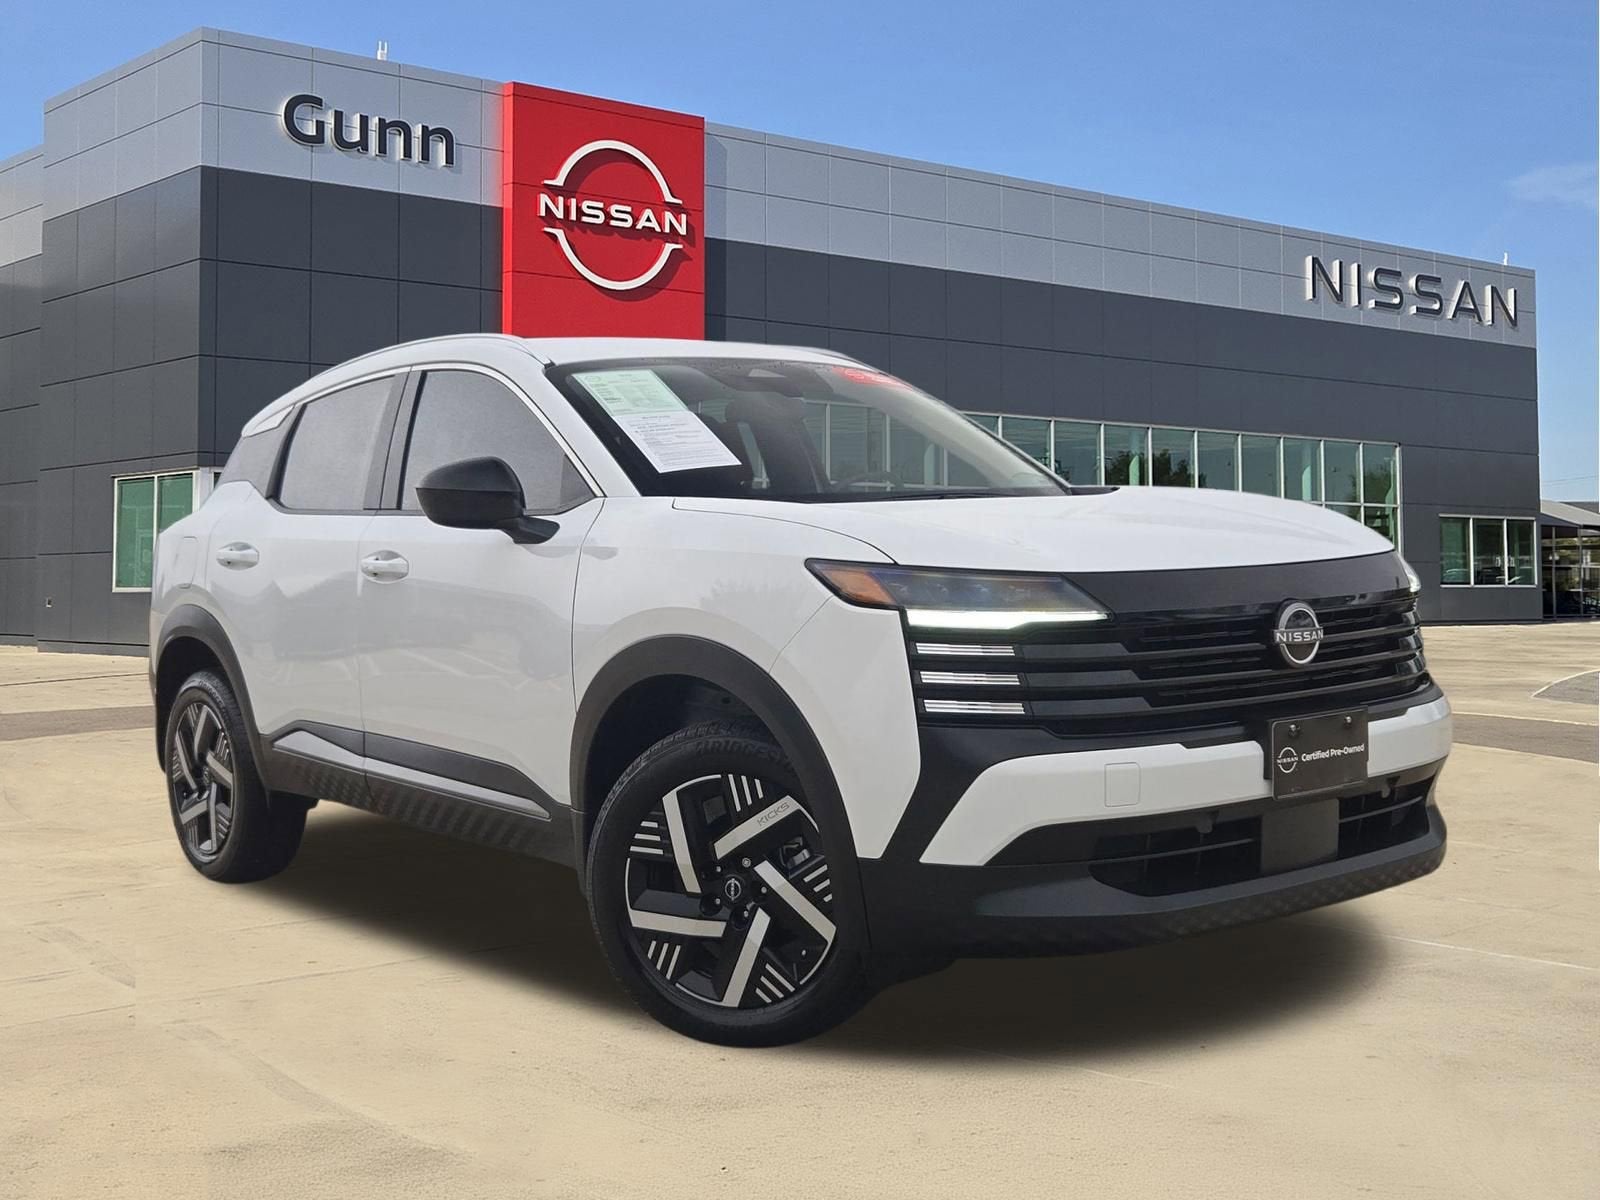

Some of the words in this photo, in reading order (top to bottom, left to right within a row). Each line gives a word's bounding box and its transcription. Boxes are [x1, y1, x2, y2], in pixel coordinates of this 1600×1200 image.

[281, 94, 455, 168] Gunn
[538, 192, 688, 236] NISSAN
[1304, 255, 1518, 328] NISSAN
[1275, 629, 1324, 643] NISSAN
[1276, 755, 1299, 764] NISSAN
[1301, 749, 1330, 762] Certified
[1330, 743, 1365, 757] Pre-Owned
[757, 801, 791, 827] KICKS
